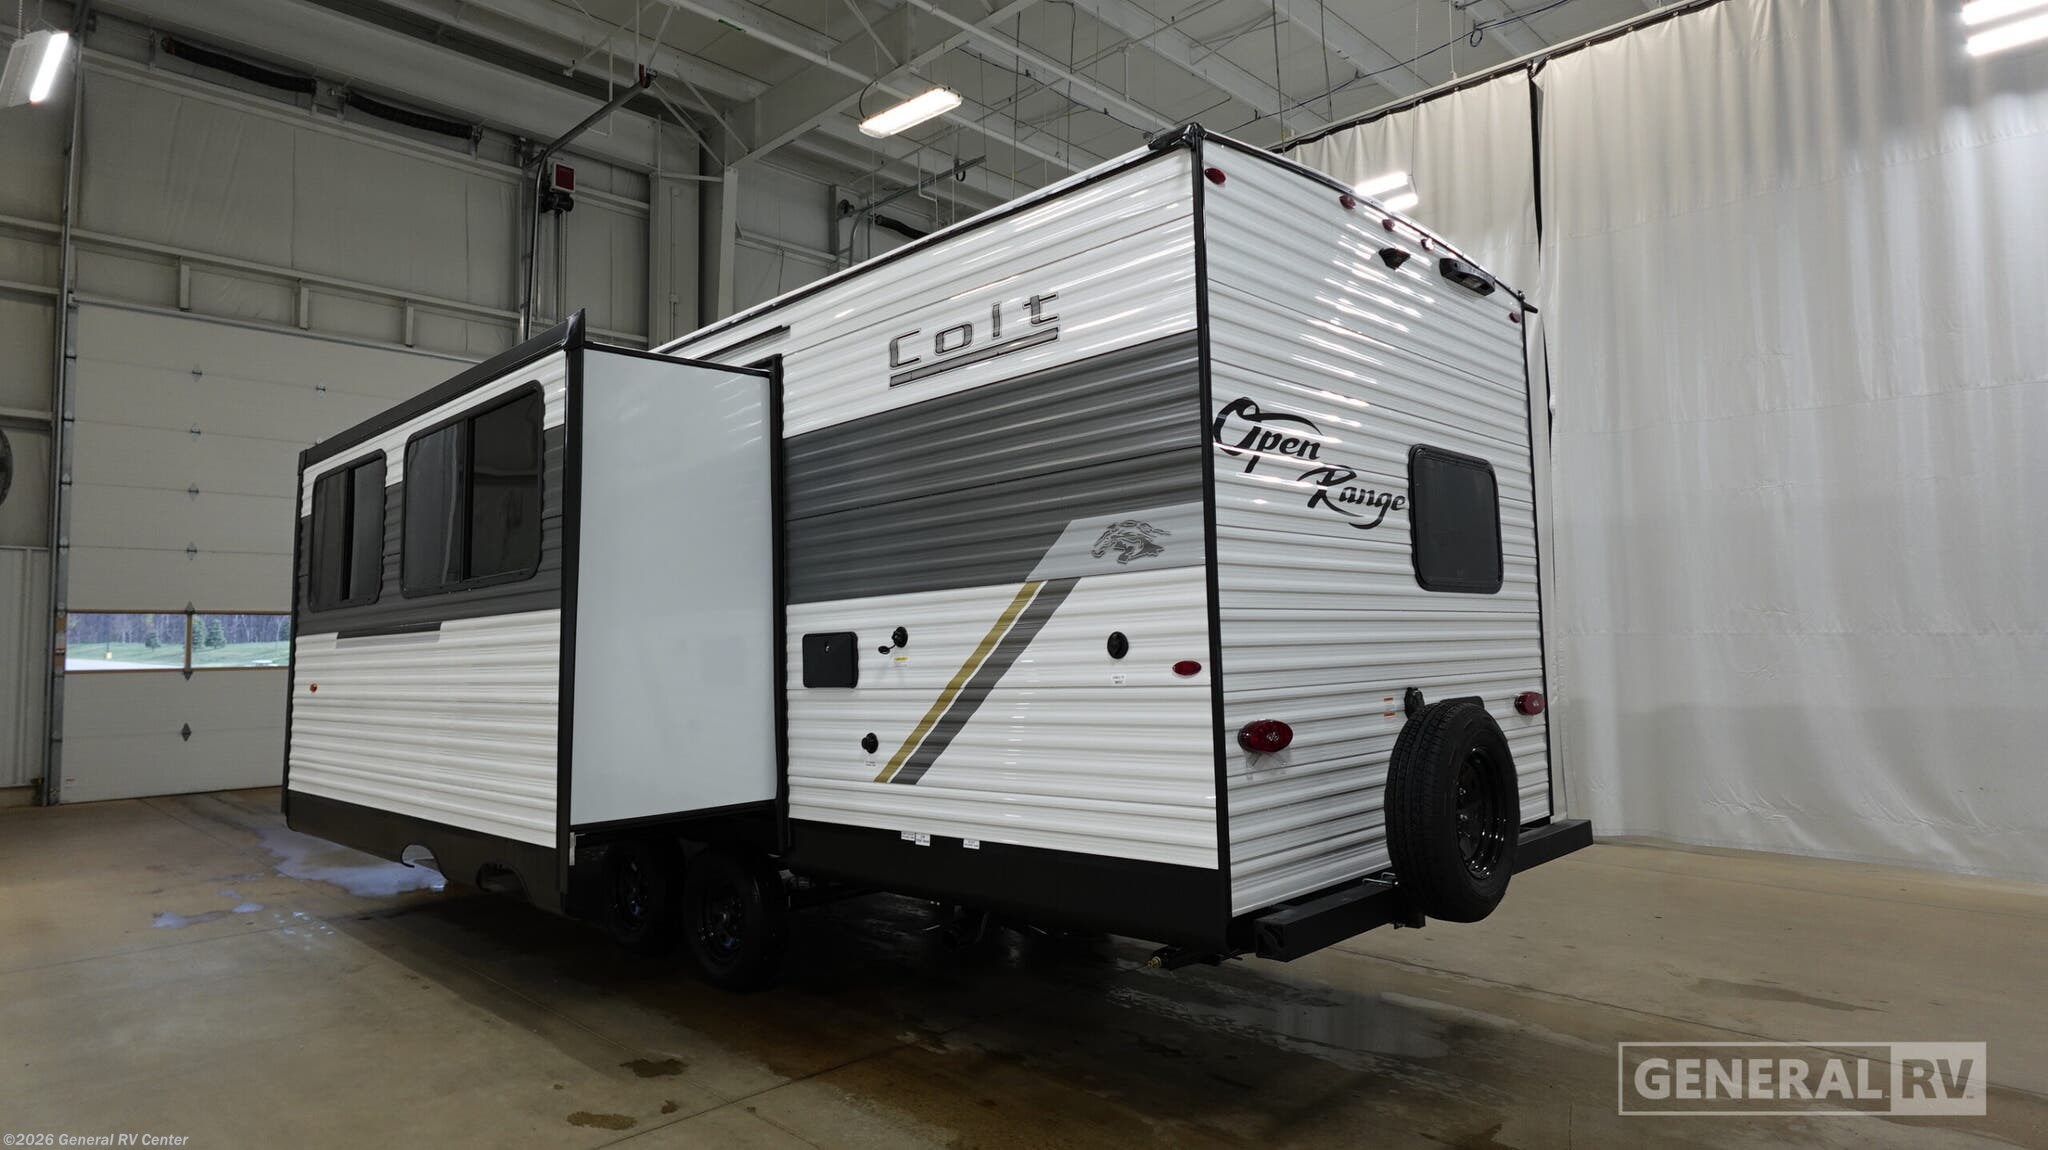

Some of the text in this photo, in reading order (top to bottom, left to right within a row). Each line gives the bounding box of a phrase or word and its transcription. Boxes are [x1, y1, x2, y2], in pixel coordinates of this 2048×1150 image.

[889, 292, 1059, 368] Colt
[1212, 397, 1322, 473] Open
[1297, 465, 1406, 529] Range
